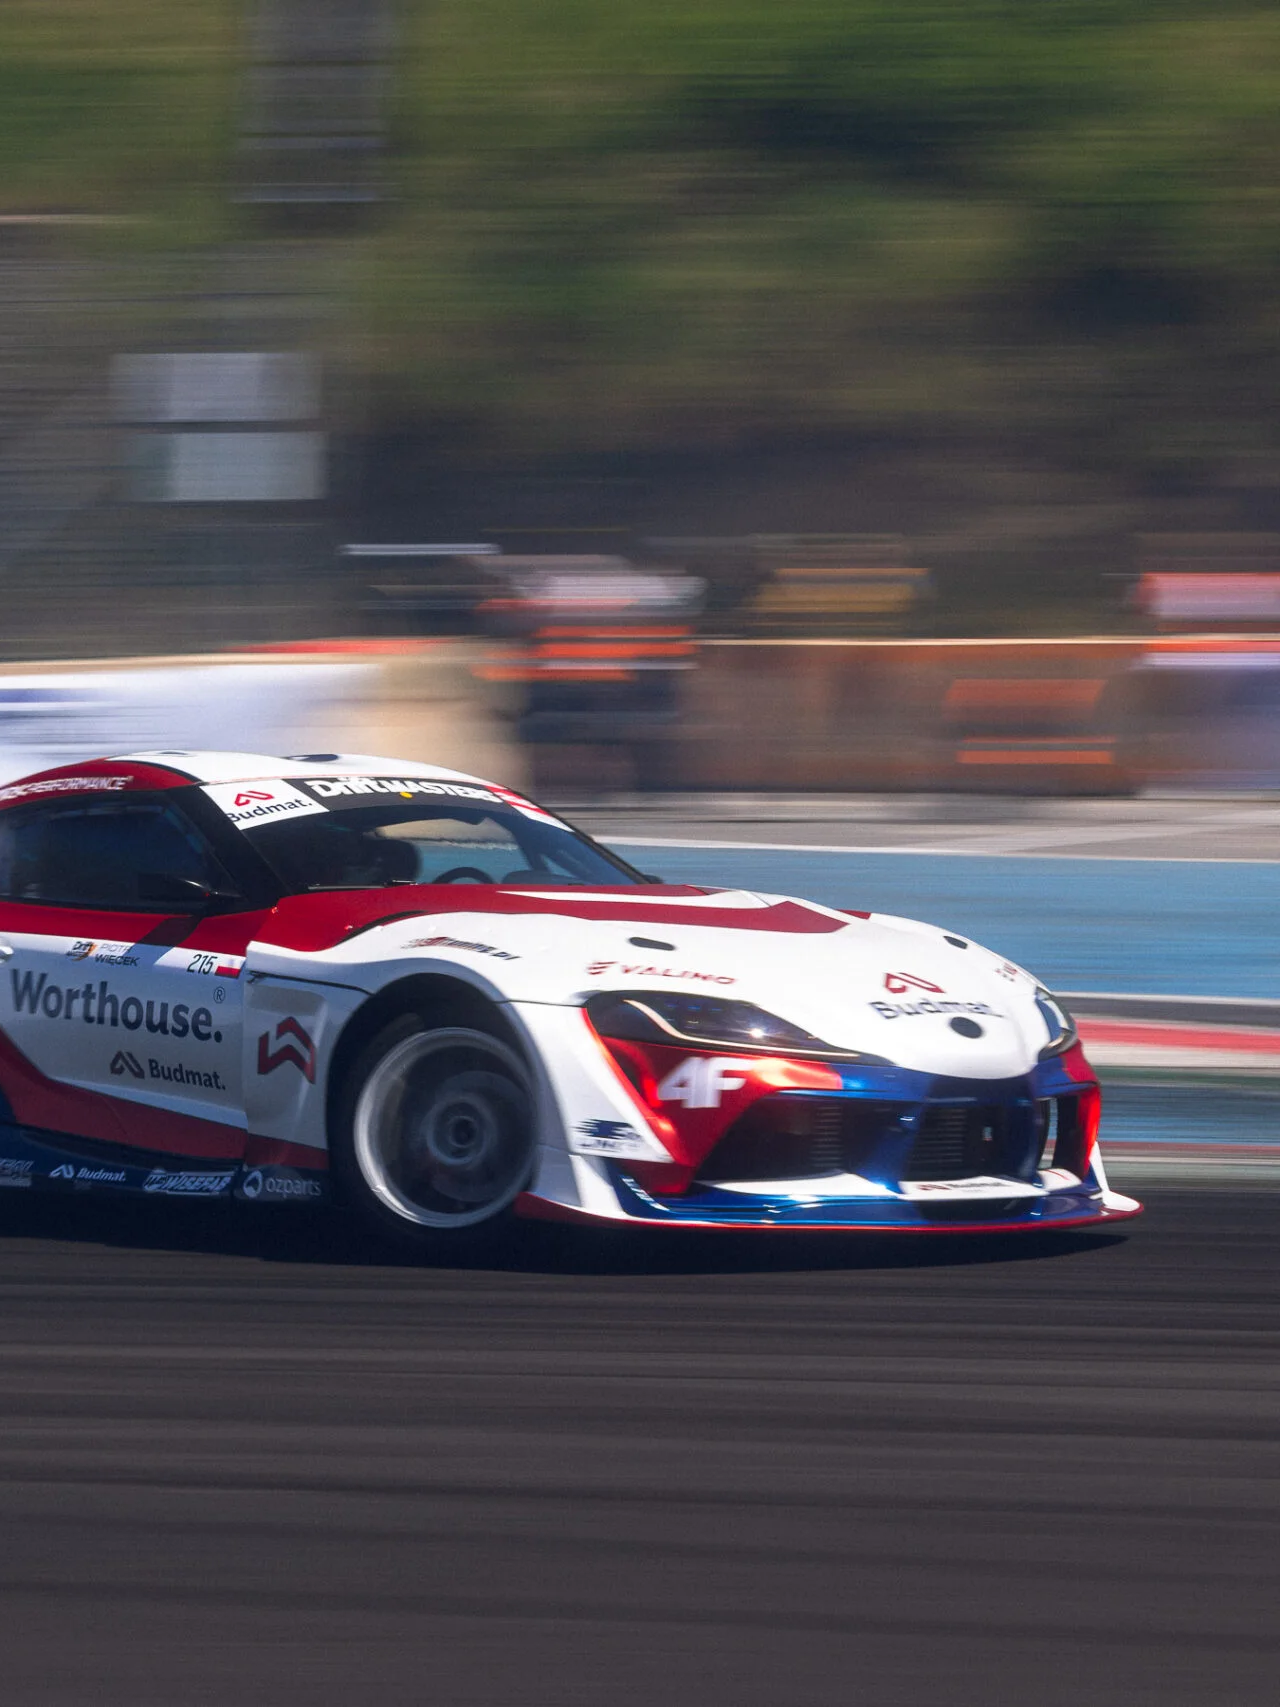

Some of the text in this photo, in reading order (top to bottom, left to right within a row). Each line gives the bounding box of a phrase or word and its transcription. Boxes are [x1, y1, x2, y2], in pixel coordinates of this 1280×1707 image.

[226, 799, 313, 823] Budmat.
[187, 954, 218, 975] 215
[621, 965, 738, 985] VALINO
[10, 968, 223, 1043] Worthouse.
[148, 1059, 226, 1090] Budmat.
[658, 1057, 756, 1109] 4F
[76, 1167, 126, 1182] Budmat.
[265, 1177, 321, 1198] ozparts
